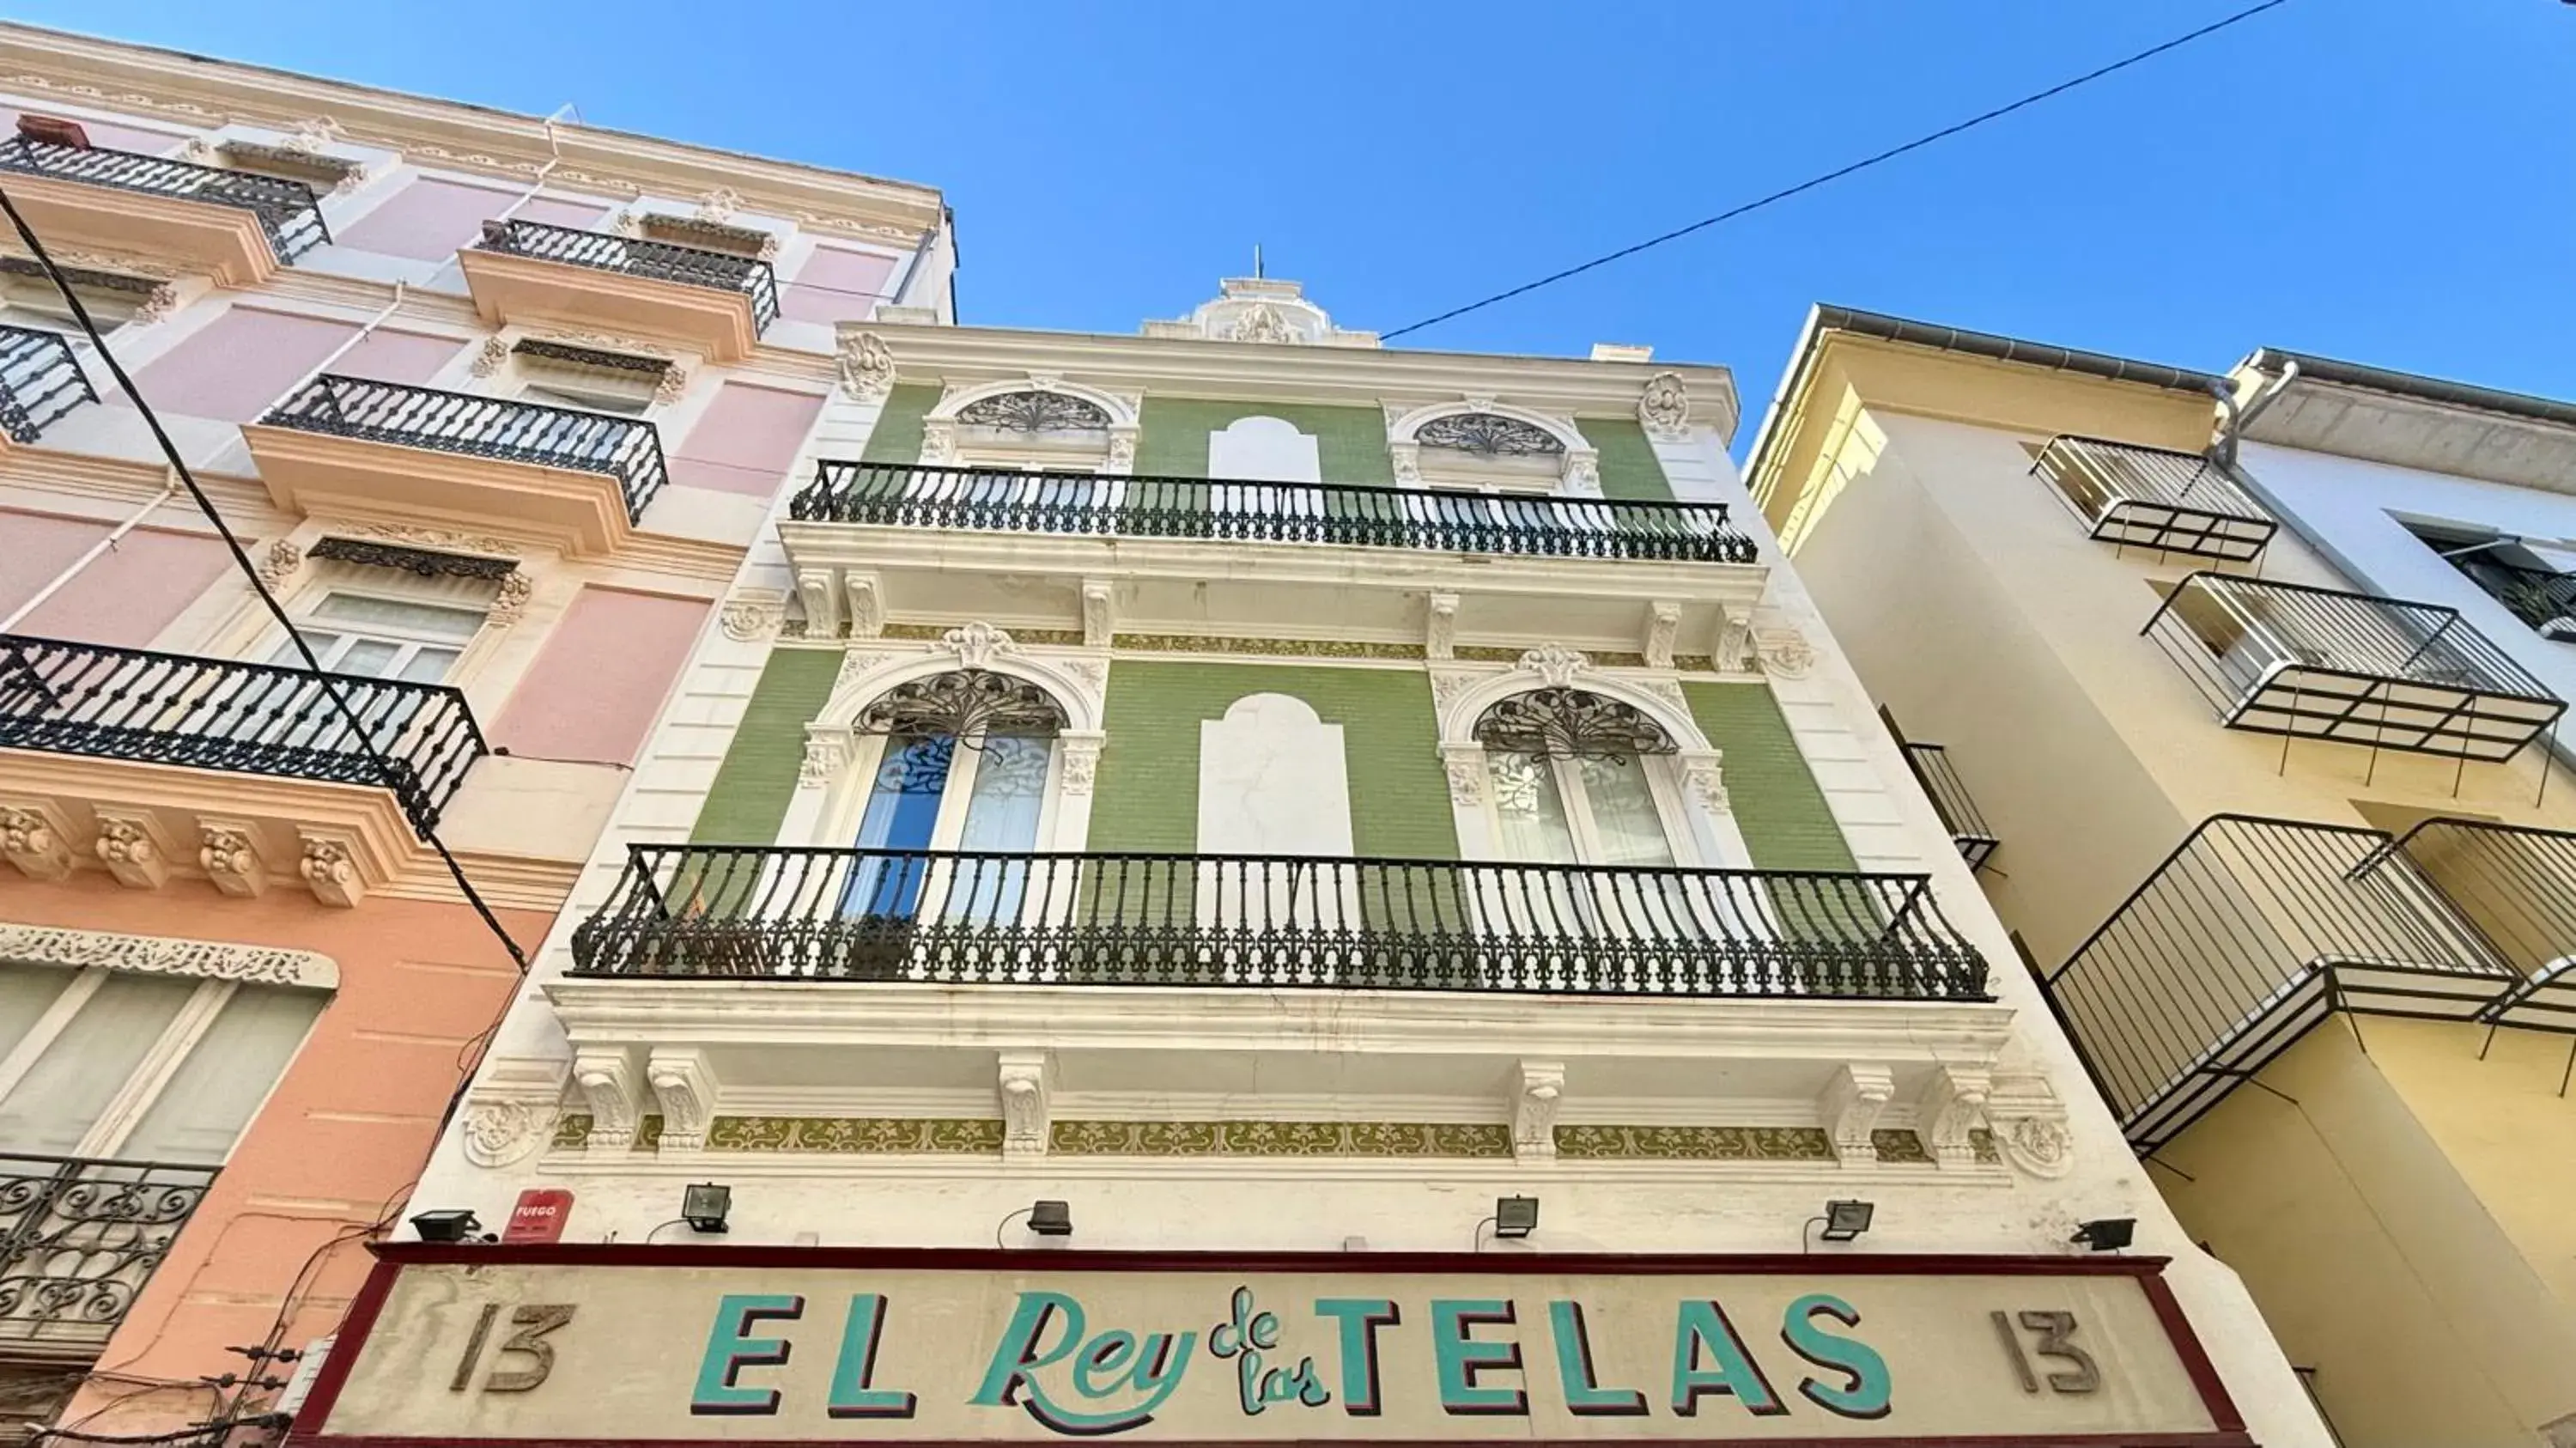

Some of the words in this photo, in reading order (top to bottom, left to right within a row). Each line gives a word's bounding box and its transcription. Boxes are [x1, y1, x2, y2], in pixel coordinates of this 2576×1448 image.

[516, 1205, 556, 1217] FUEGO
[448, 1303, 579, 1392] 13
[690, 1293, 918, 1419] EL
[965, 1291, 1197, 1436] Rey
[1209, 1286, 1279, 1358] de
[1314, 1293, 1893, 1420] TELAS
[1990, 1310, 2100, 1393] 13
[1238, 1348, 1330, 1415] las
